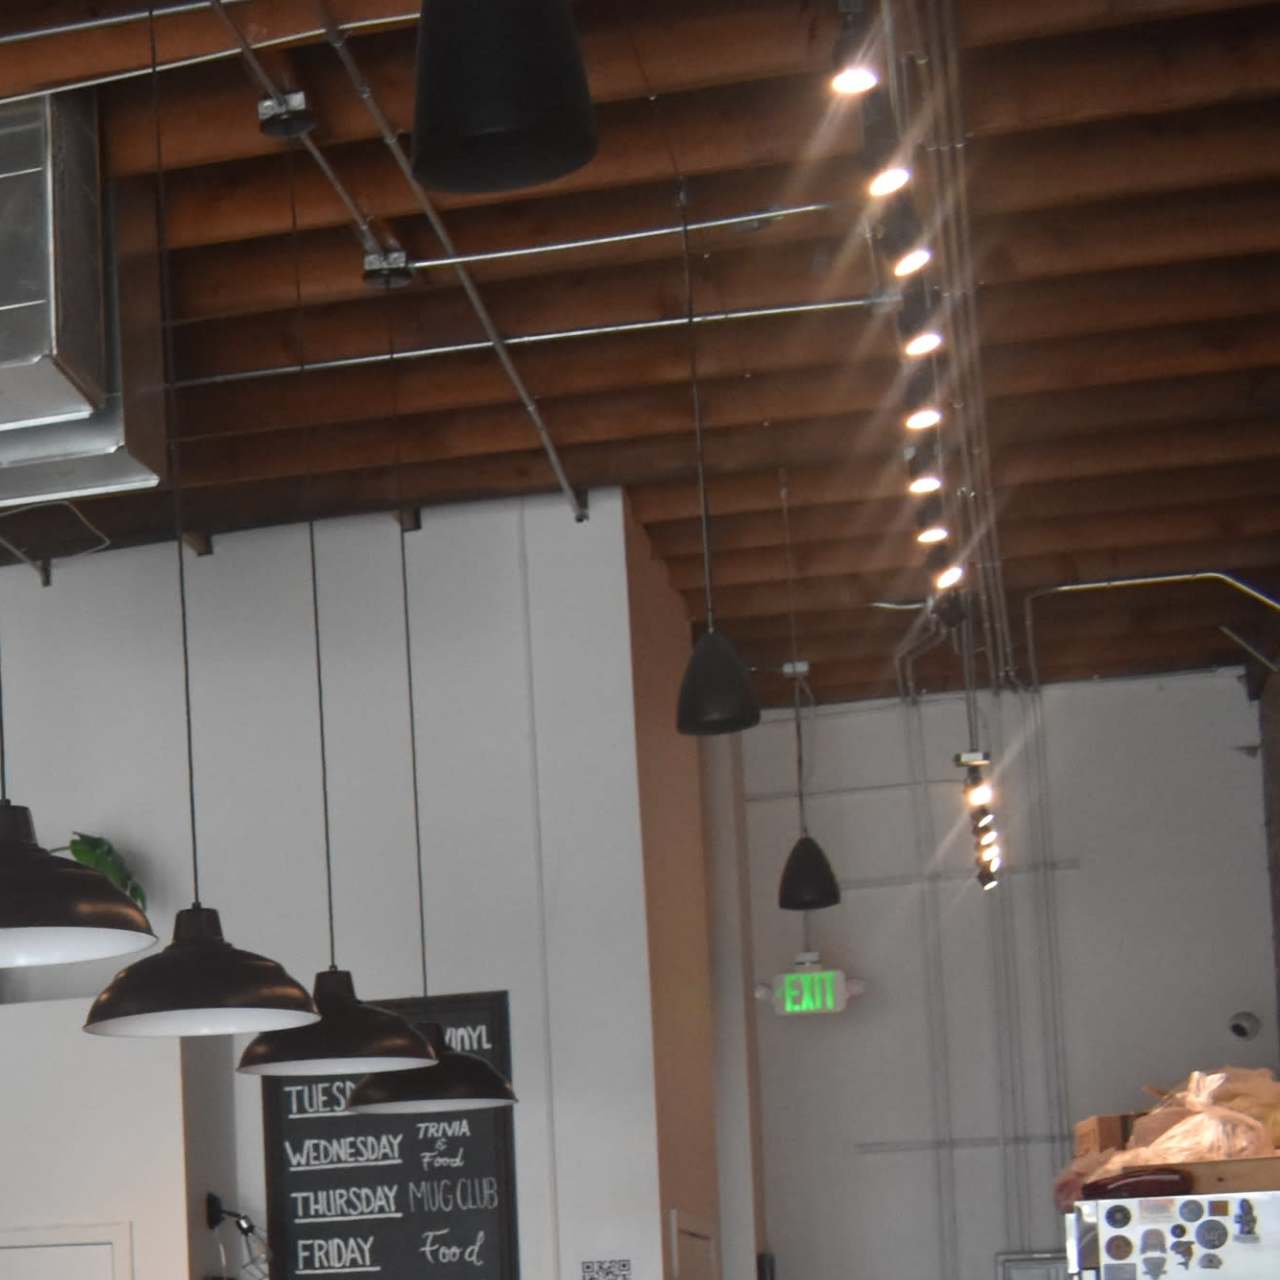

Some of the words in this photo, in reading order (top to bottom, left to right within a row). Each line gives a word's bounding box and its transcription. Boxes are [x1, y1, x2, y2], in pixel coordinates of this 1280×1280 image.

[784, 972, 836, 1012] EXIT
[285, 1134, 403, 1166] WEDNESDAY
[416, 1119, 470, 1139] TRIVIA
[420, 1150, 465, 1169] Food
[291, 1185, 399, 1216] THURSDAY
[409, 1181, 452, 1213] MUG
[456, 1178, 499, 1210] CLUB
[297, 1236, 375, 1269] FRIDAY
[419, 1229, 485, 1267] Food
